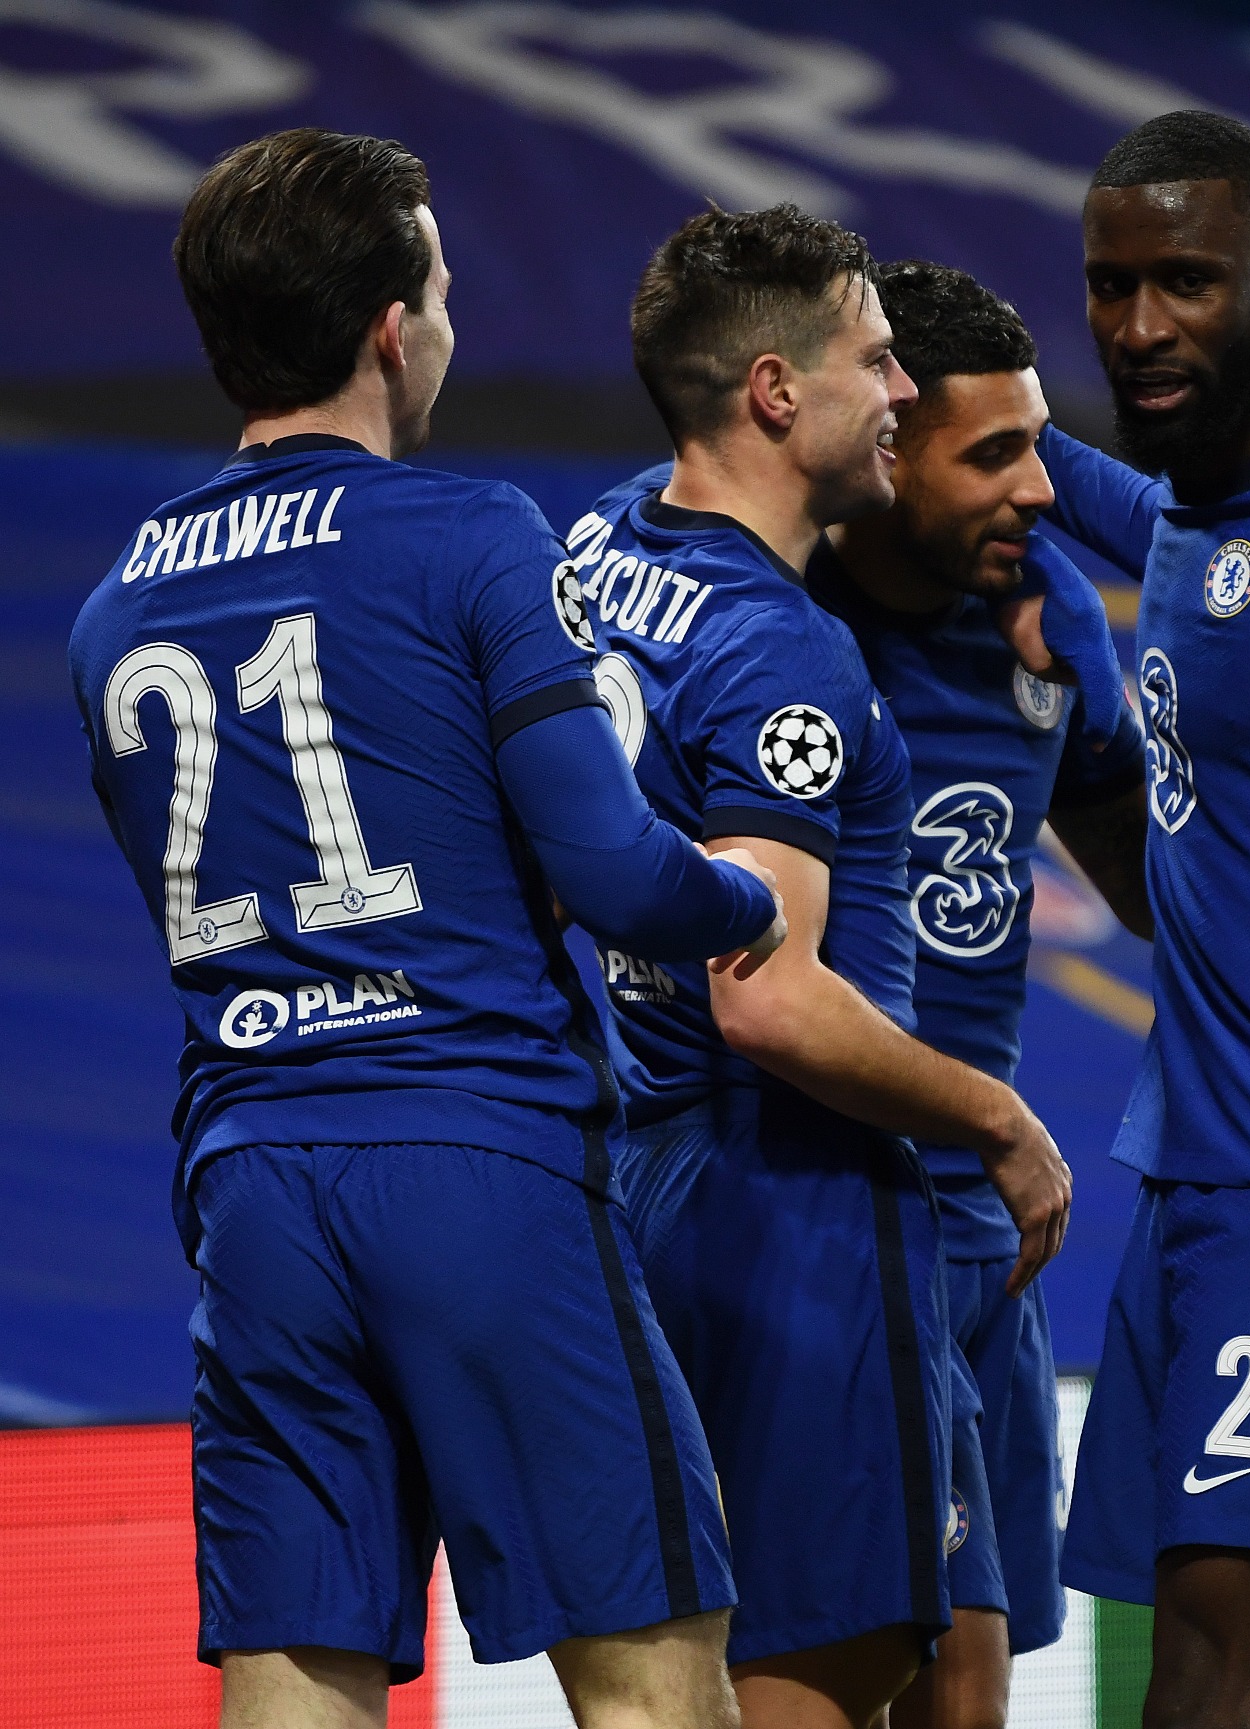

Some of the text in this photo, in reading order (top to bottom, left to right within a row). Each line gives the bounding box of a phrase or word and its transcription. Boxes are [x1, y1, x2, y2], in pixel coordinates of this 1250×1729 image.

[121, 486, 345, 583] CHILWELL
[104, 612, 424, 967] 21
[296, 969, 415, 1020] PLAN
[297, 1004, 422, 1036] INTERNATIONAL
